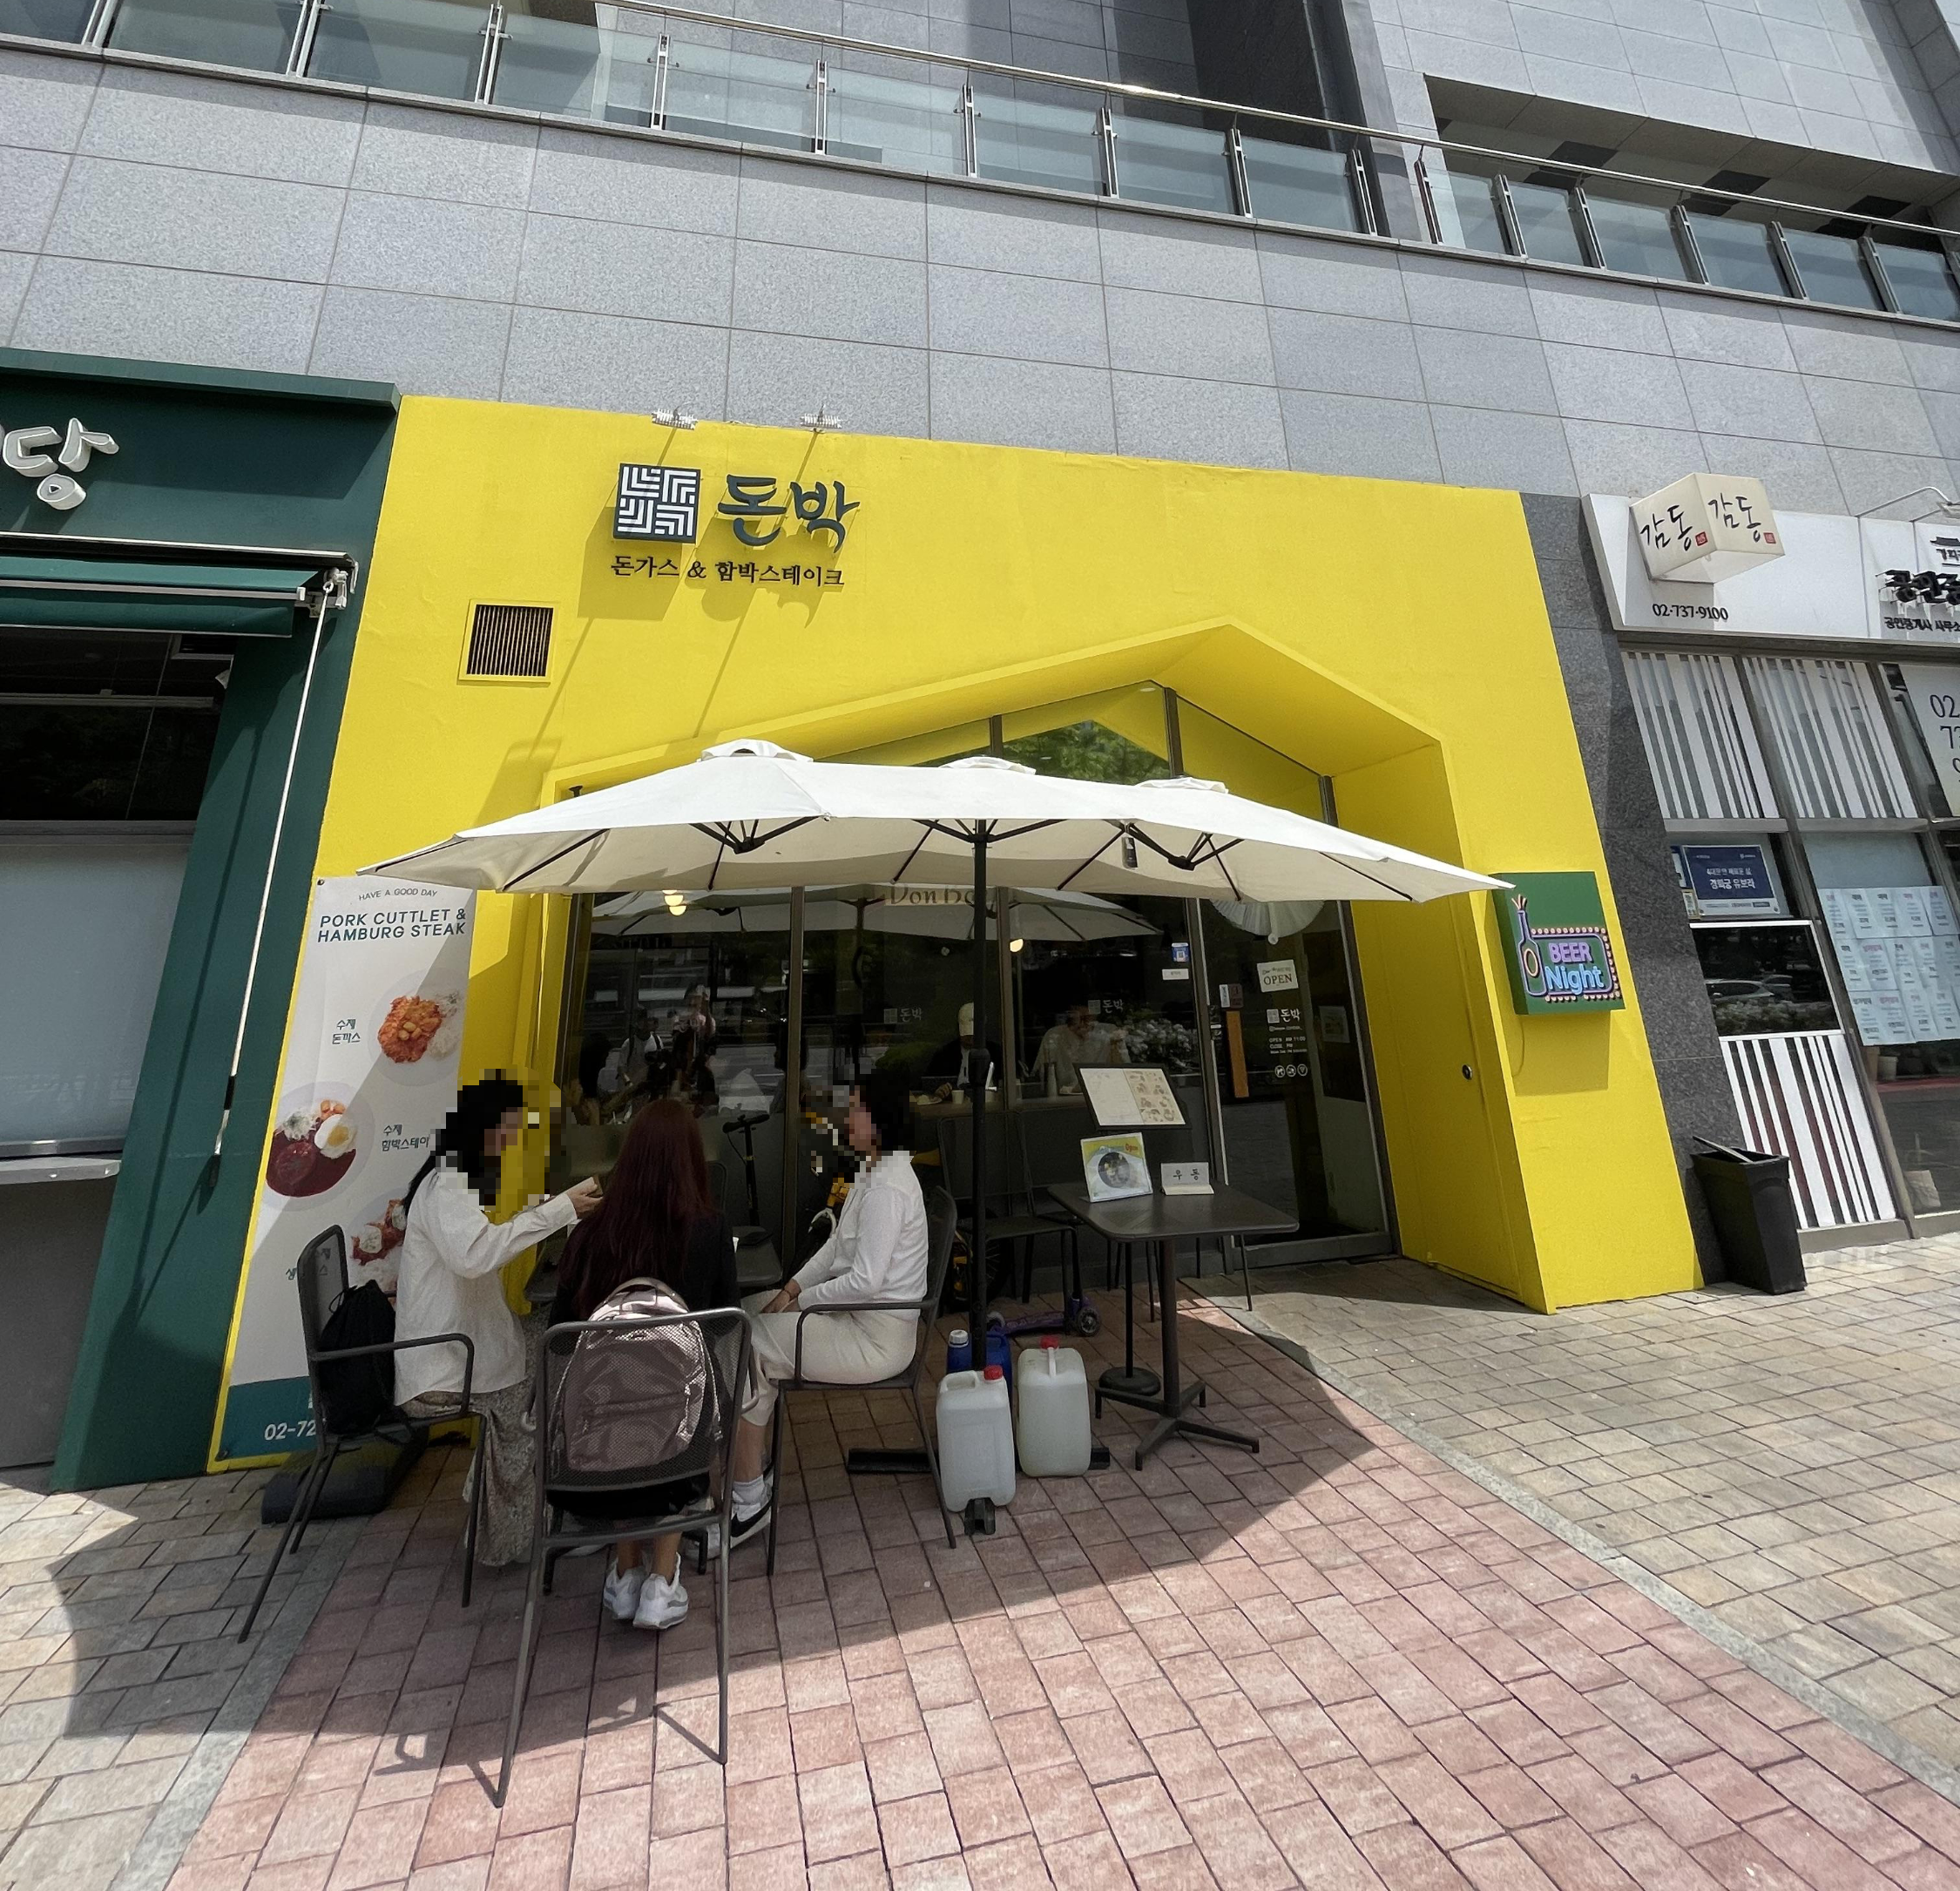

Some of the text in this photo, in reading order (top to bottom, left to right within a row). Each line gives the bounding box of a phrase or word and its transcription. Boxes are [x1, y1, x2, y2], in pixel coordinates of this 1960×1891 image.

[0, 417, 119, 510] 당
[717, 474, 861, 553] 돈박
[1708, 493, 1762, 542] 감동
[1640, 505, 1693, 550] 감동
[611, 555, 845, 586] 돈가스 & 함박스테이크
[1883, 616, 1933, 631] 공인중개사
[358, 890, 382, 901] HAVE
[394, 888, 418, 896] GOOD
[421, 888, 438, 898] DAY
[320, 908, 467, 929] PORK CUTTLET &
[317, 922, 466, 943] HAMBURG STEAK
[1548, 942, 1593, 963] BEER
[1263, 974, 1293, 986] OPEN
[1544, 963, 1605, 996] Night
[336, 1019, 356, 1030] 수제
[1281, 1008, 1301, 1023] 돈박
[383, 1124, 402, 1136] 수제
[382, 1137, 429, 1151] 함박스테이
[264, 1420, 316, 1441] 02-72
